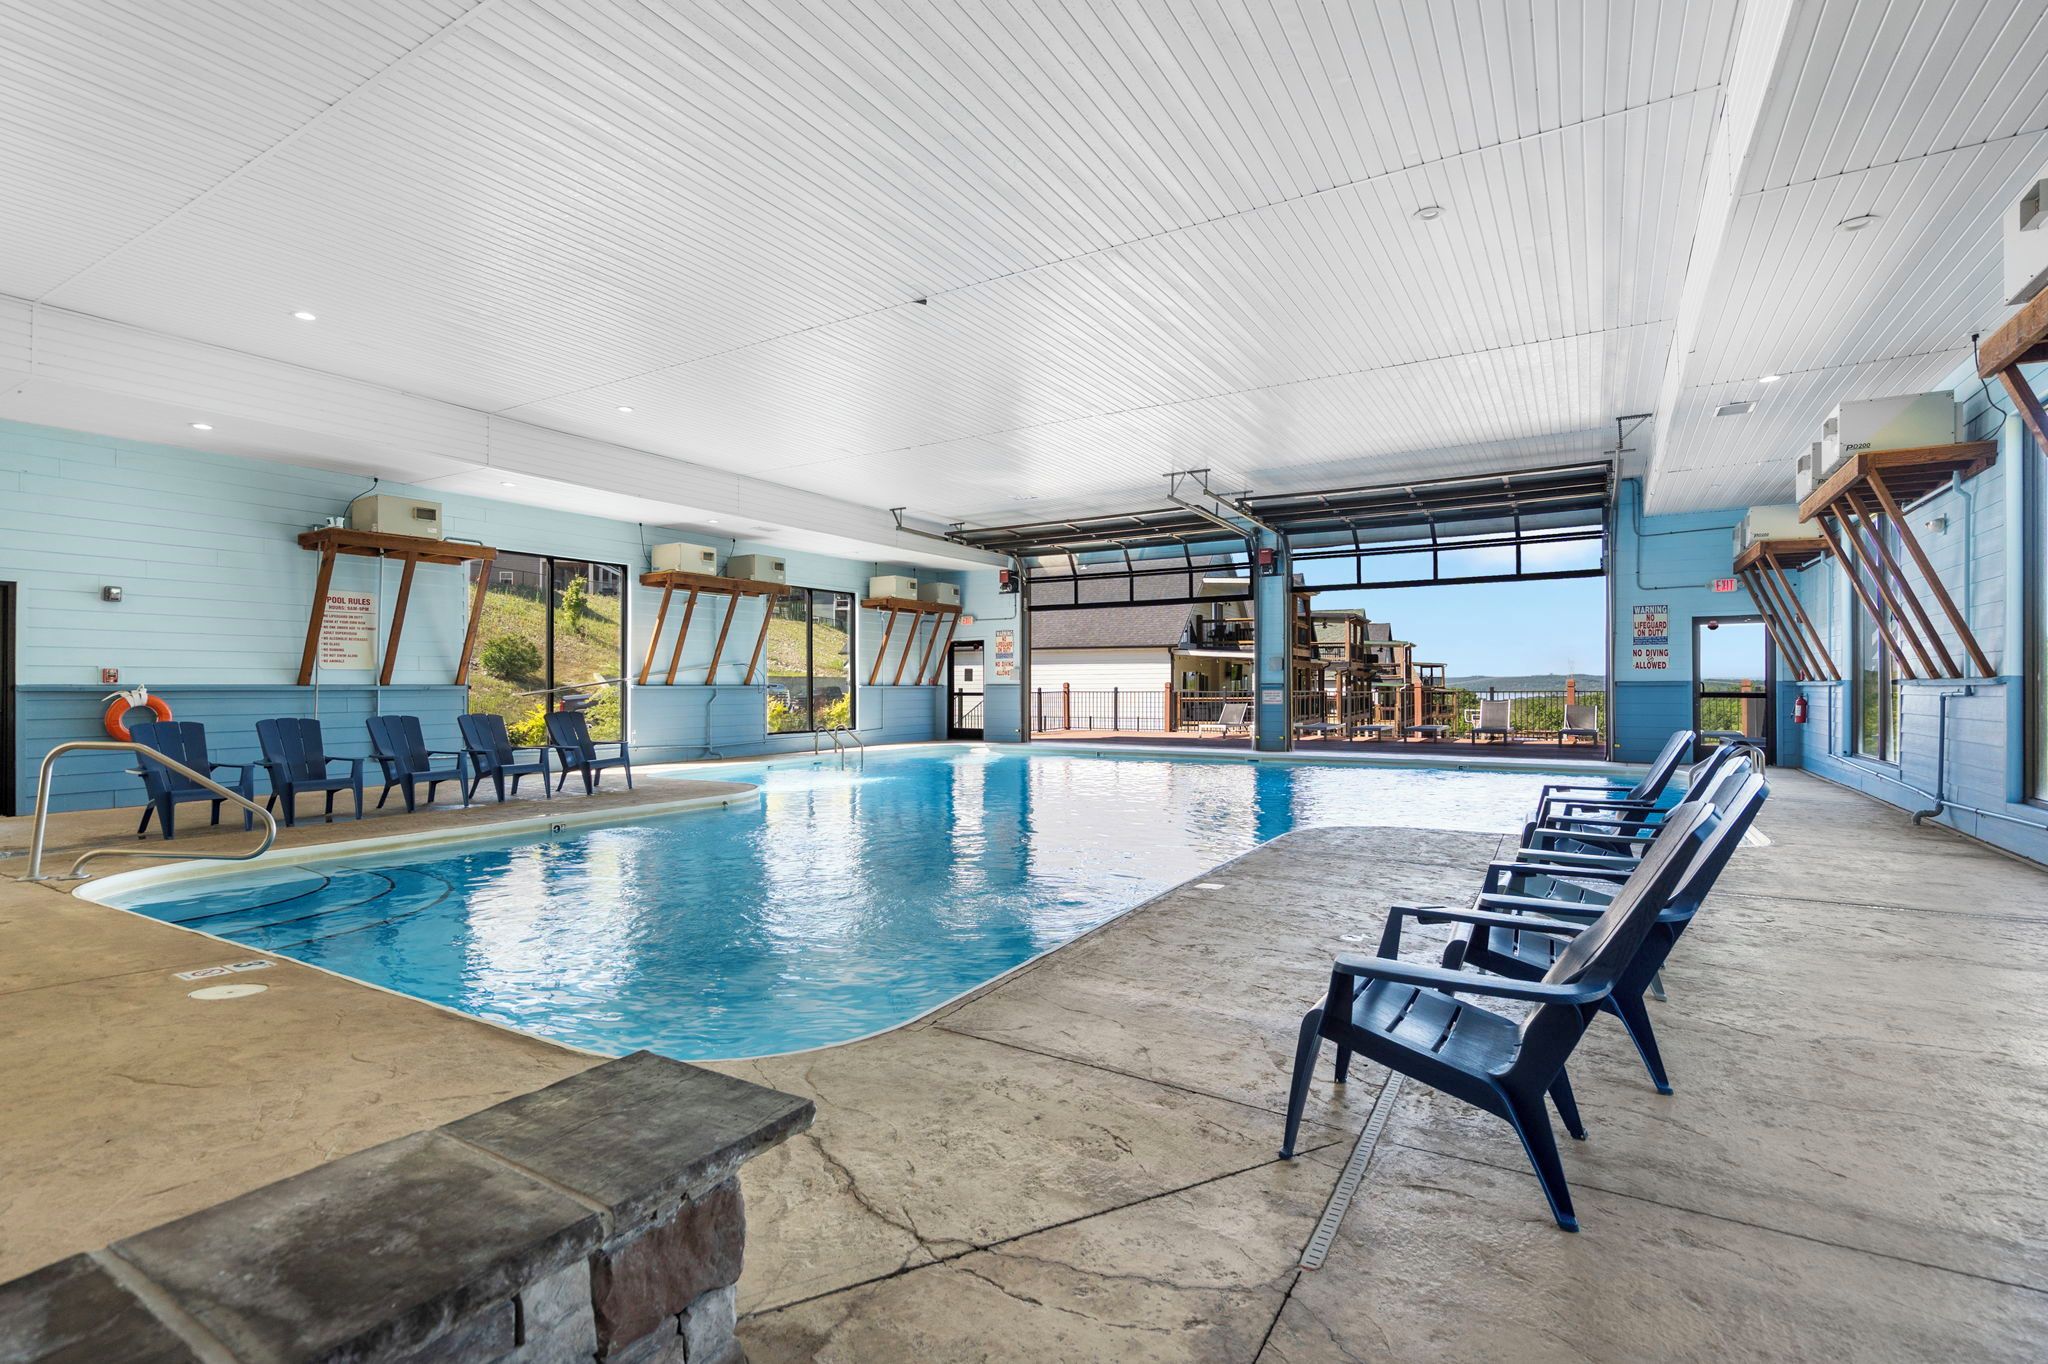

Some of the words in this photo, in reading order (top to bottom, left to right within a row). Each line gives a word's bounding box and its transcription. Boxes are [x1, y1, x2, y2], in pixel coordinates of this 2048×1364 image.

[1846, 442, 1871, 451] PD200
[1715, 579, 1735, 591] EXIT
[326, 596, 346, 604] POOL
[1634, 606, 1667, 614] WARNING
